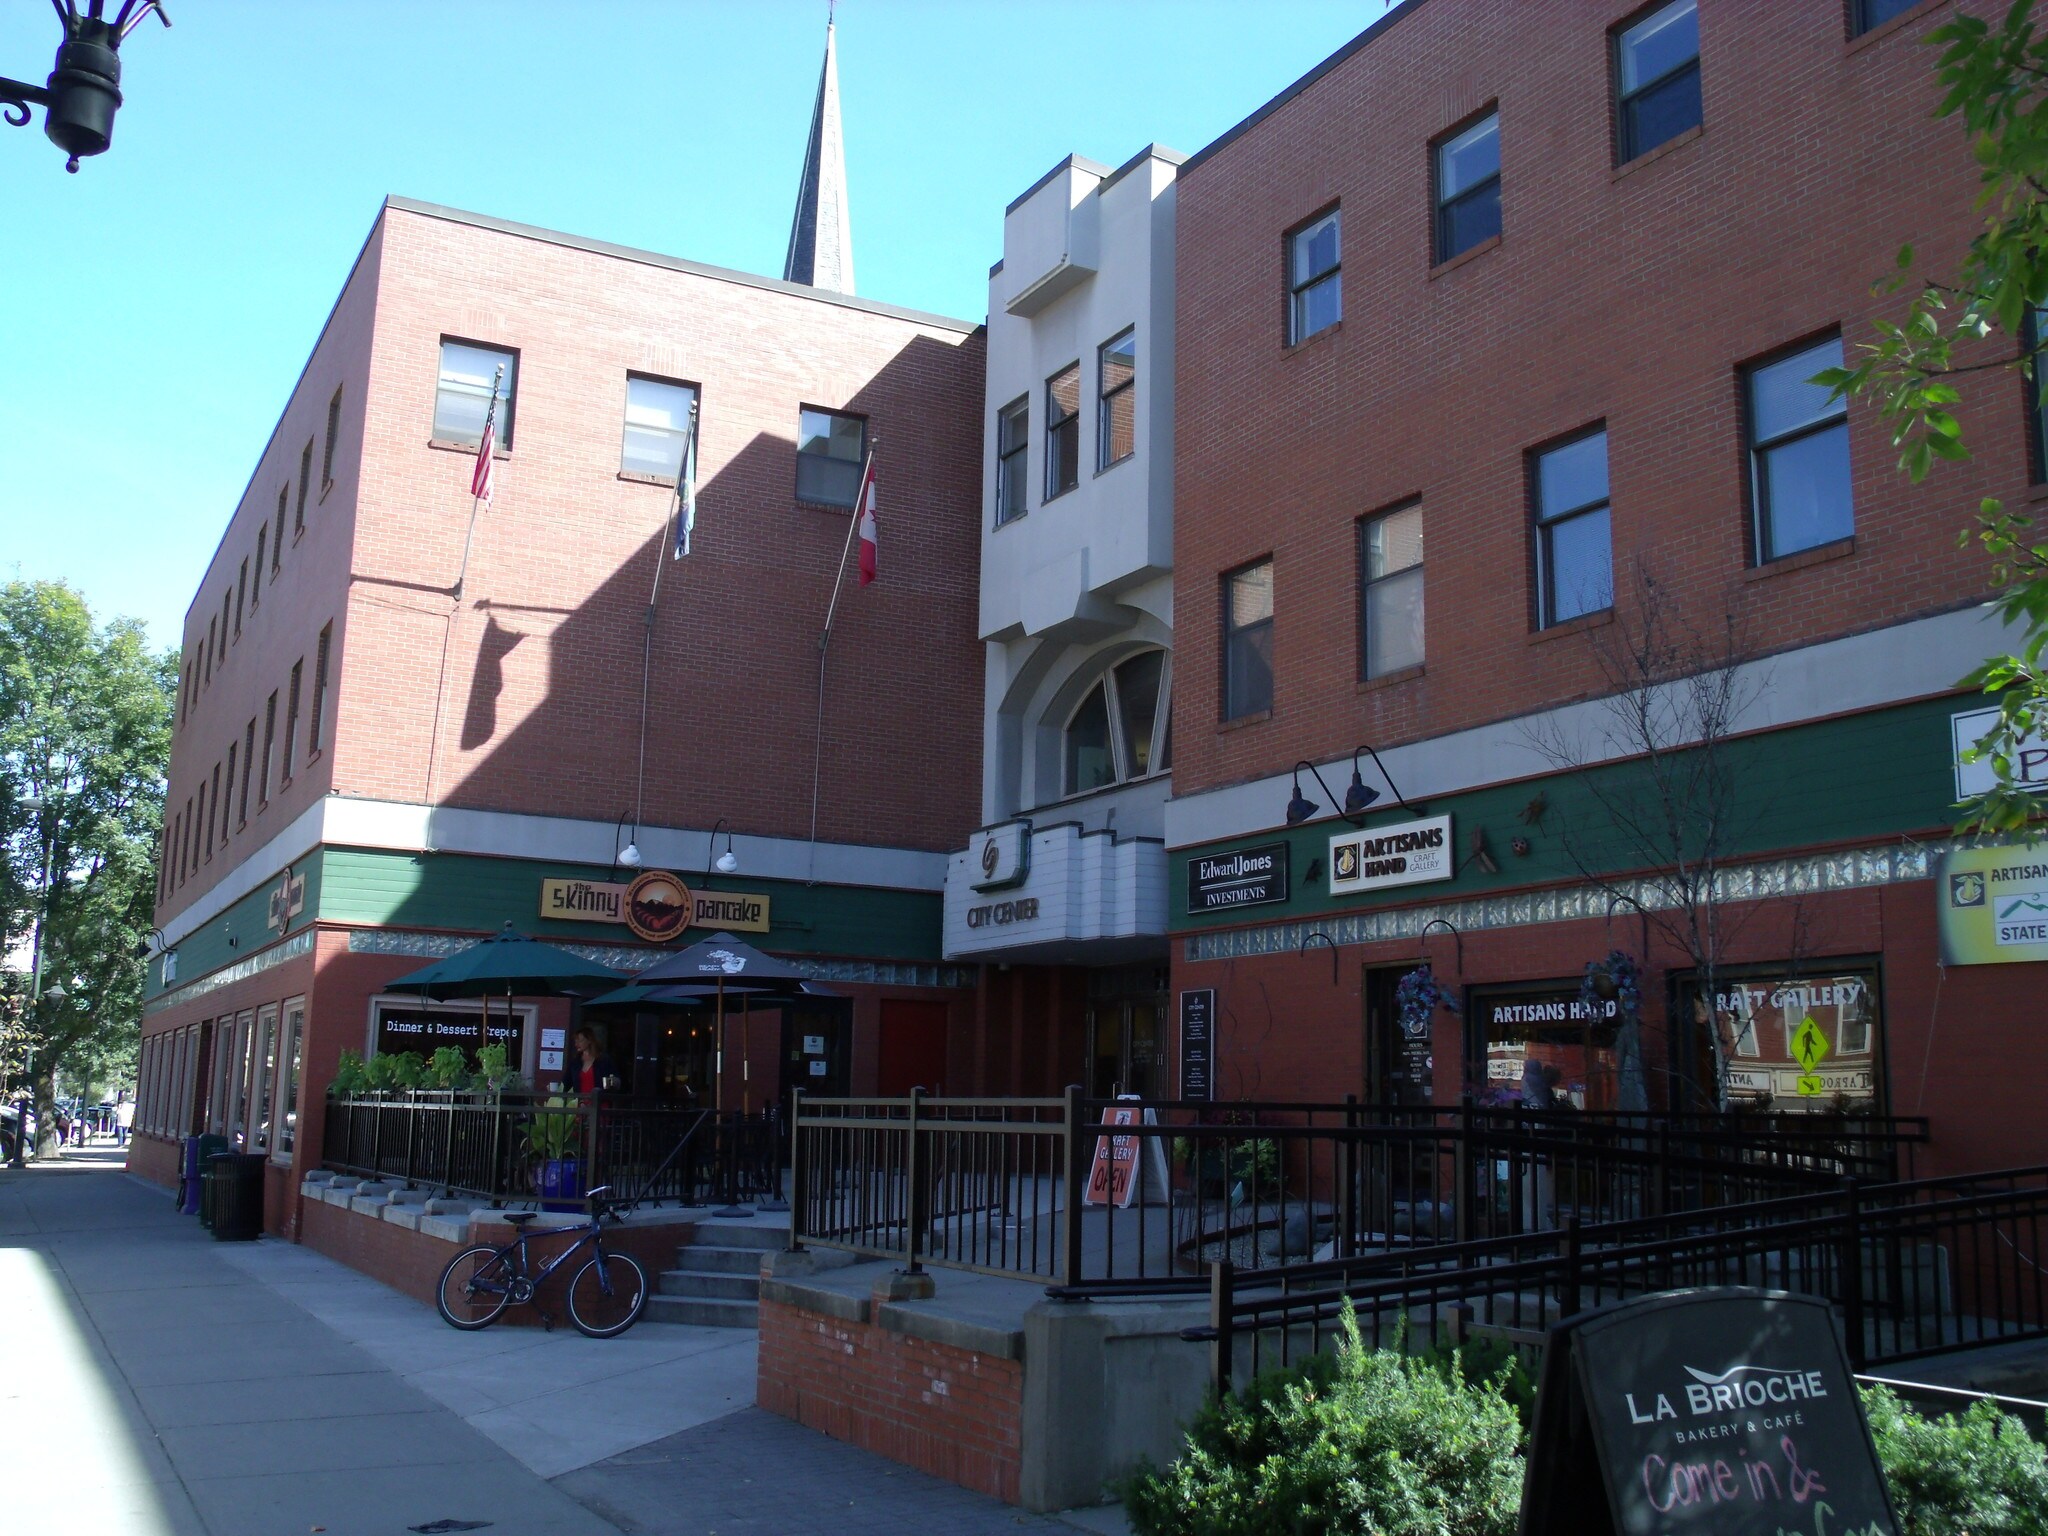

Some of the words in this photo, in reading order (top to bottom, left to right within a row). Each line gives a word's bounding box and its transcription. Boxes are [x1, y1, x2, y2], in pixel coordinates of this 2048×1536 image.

[1363, 828, 1443, 858] ARTISANS
[1364, 856, 1407, 878] HAND
[1409, 859, 1440, 872] GALLERY
[1413, 852, 1436, 862] CRAFT
[1207, 886, 1266, 906] INVESTMENTS
[696, 898, 761, 922] pancake
[967, 904, 993, 928] CITY
[993, 897, 1040, 924] CENTER
[2001, 925, 2047, 941] STATE
[1715, 990, 1767, 1011] RAFT
[1770, 984, 1861, 1008] GALLERY
[1493, 1003, 1566, 1024] ARTISANS
[387, 1020, 423, 1033] Dinner
[427, 1023, 433, 1033] &
[436, 1023, 478, 1036] Dessert
[1112, 1135, 1132, 1146] RAFT
[1100, 1147, 1133, 1160] GALERY
[1625, 1392, 1678, 1425] LA
[1685, 1371, 1828, 1416] BRIOCHE
[1675, 1423, 1739, 1444] BAKERY
[1747, 1420, 1757, 1432] &
[1642, 1453, 1740, 1513] Come
[1740, 1447, 1782, 1501] in
[1780, 1434, 1827, 1503] &
